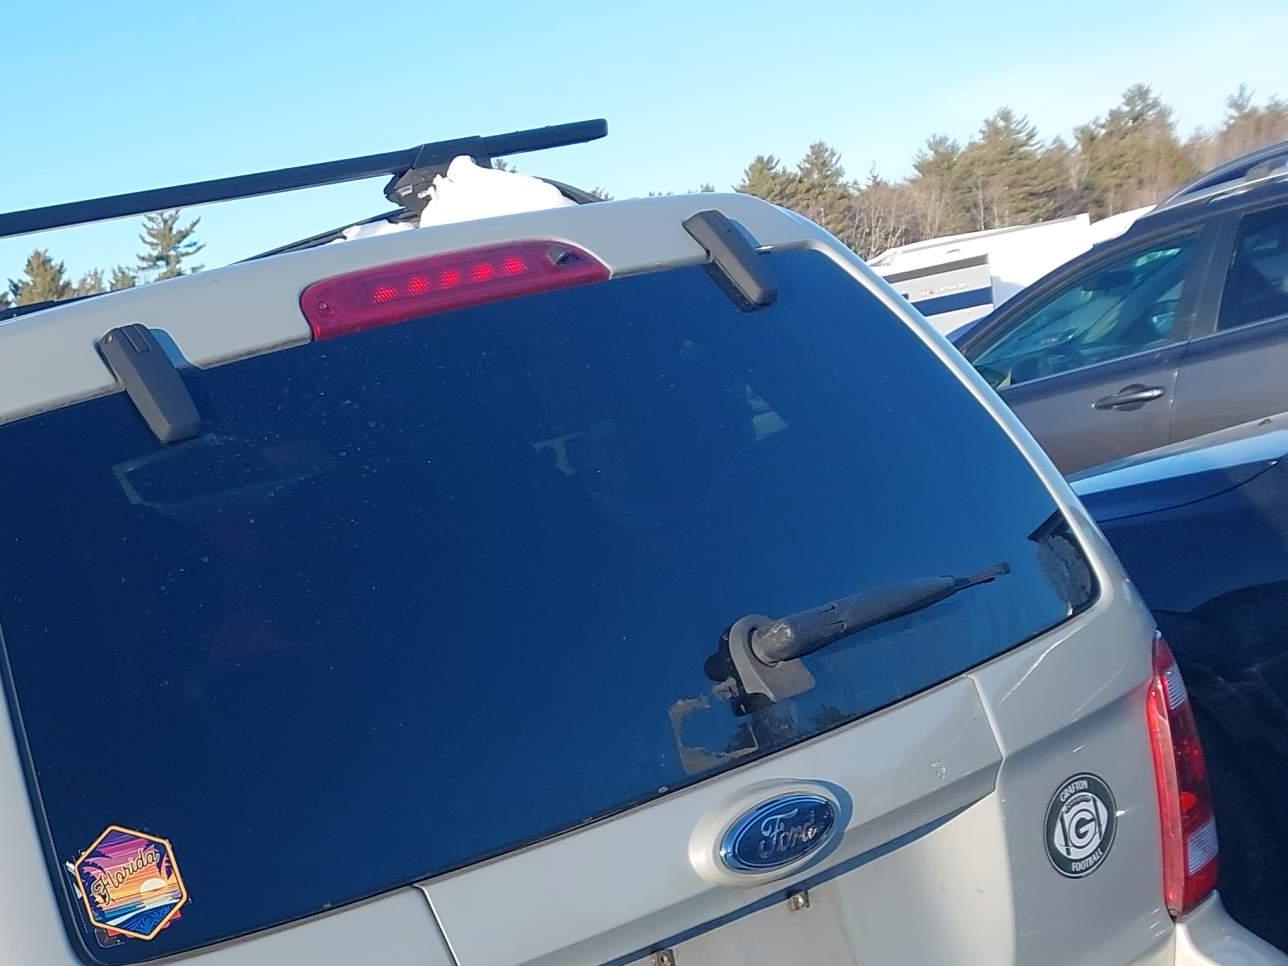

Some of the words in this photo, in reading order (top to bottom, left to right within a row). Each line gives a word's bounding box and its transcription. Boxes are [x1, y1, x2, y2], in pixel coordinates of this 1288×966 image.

[760, 808, 820, 858] Ford
[91, 847, 161, 905] Florida
[1072, 847, 1104, 872] FOOTBALL
